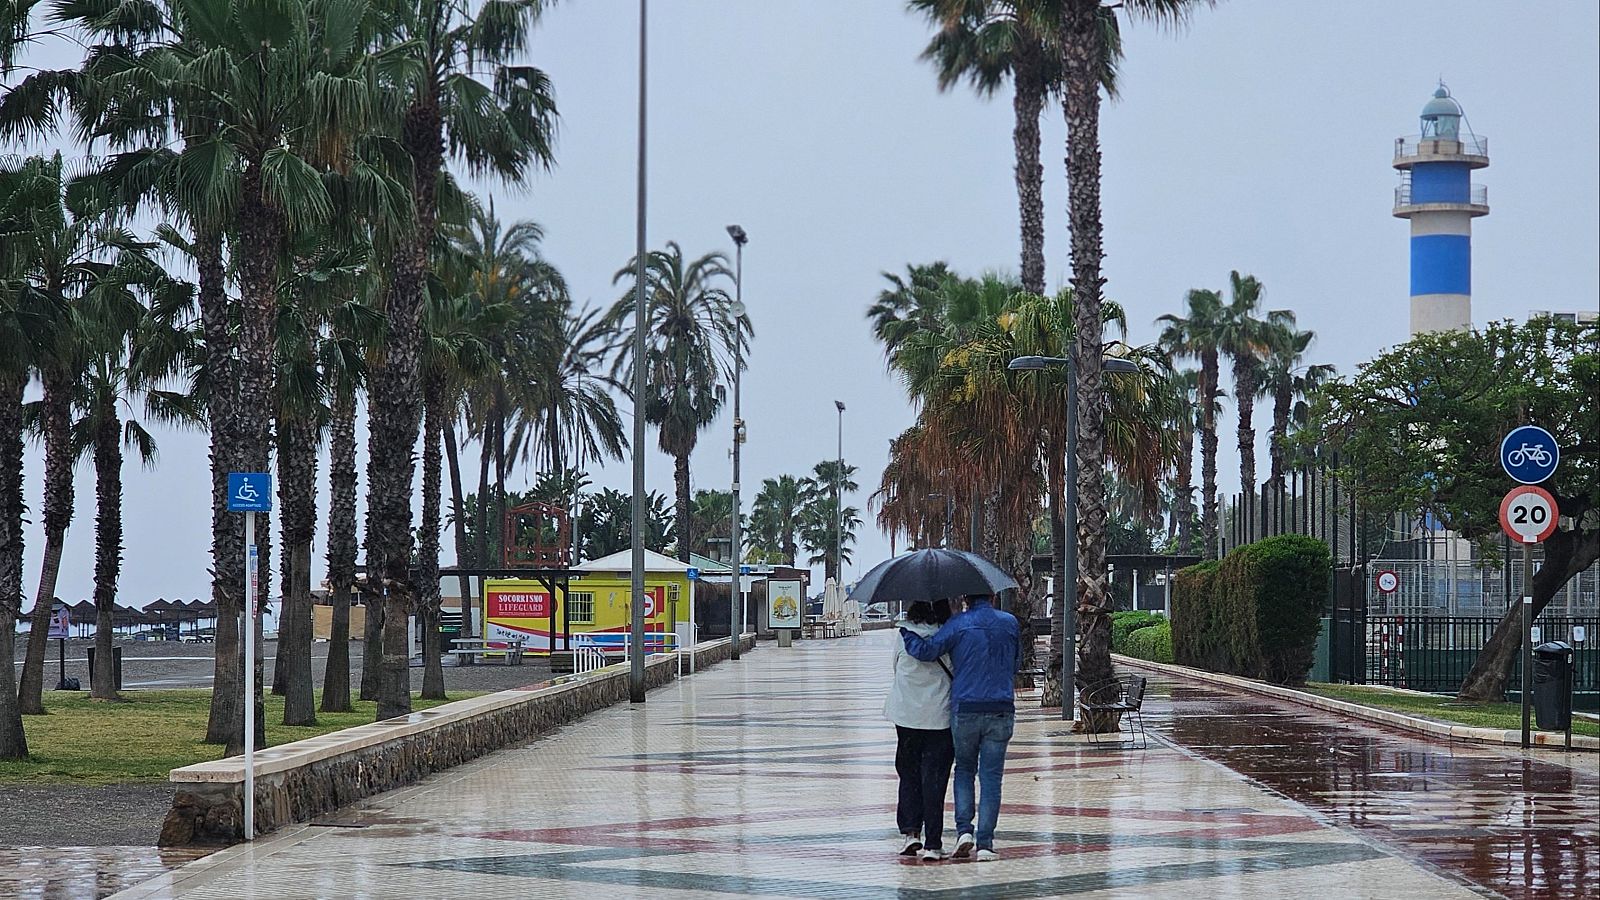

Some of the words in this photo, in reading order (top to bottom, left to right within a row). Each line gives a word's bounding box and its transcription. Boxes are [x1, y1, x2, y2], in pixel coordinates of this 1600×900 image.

[1513, 505, 1546, 524] 20
[498, 594, 543, 603] SOCORRISMO
[498, 603, 543, 612] LIFEGUARD
